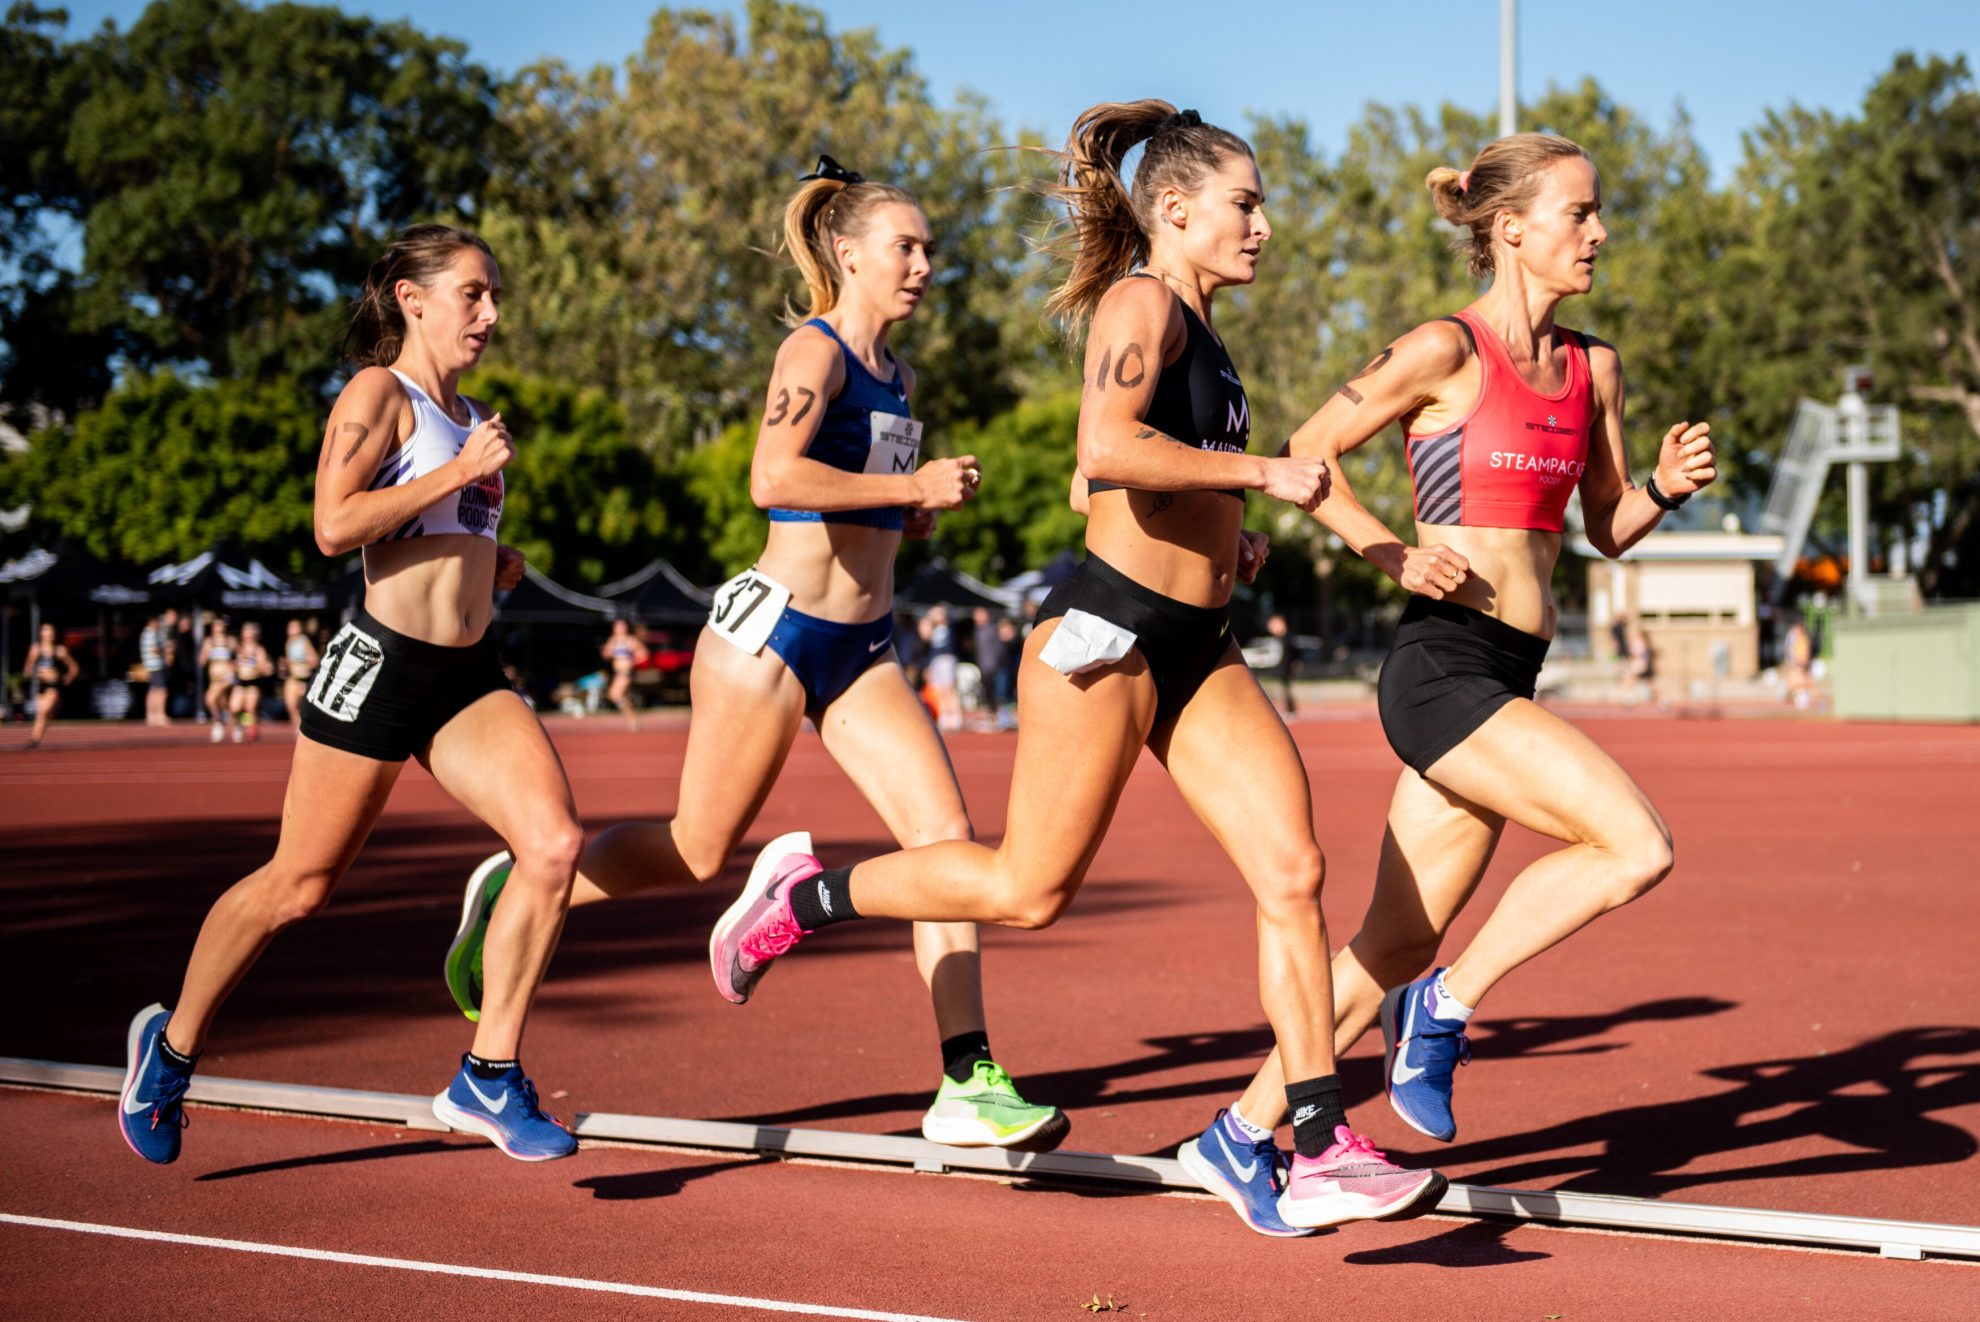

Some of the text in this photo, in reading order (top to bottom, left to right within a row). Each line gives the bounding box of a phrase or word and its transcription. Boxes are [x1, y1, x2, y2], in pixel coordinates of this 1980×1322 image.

[1096, 343, 1145, 393] 10
[767, 386, 816, 427] 37
[324, 422, 370, 468] 17
[457, 503, 499, 532] PODCAST
[460, 484, 503, 513] RUNNING
[714, 576, 772, 634] 37
[316, 631, 382, 713] 17
[1295, 1104, 1316, 1119] NIKE
